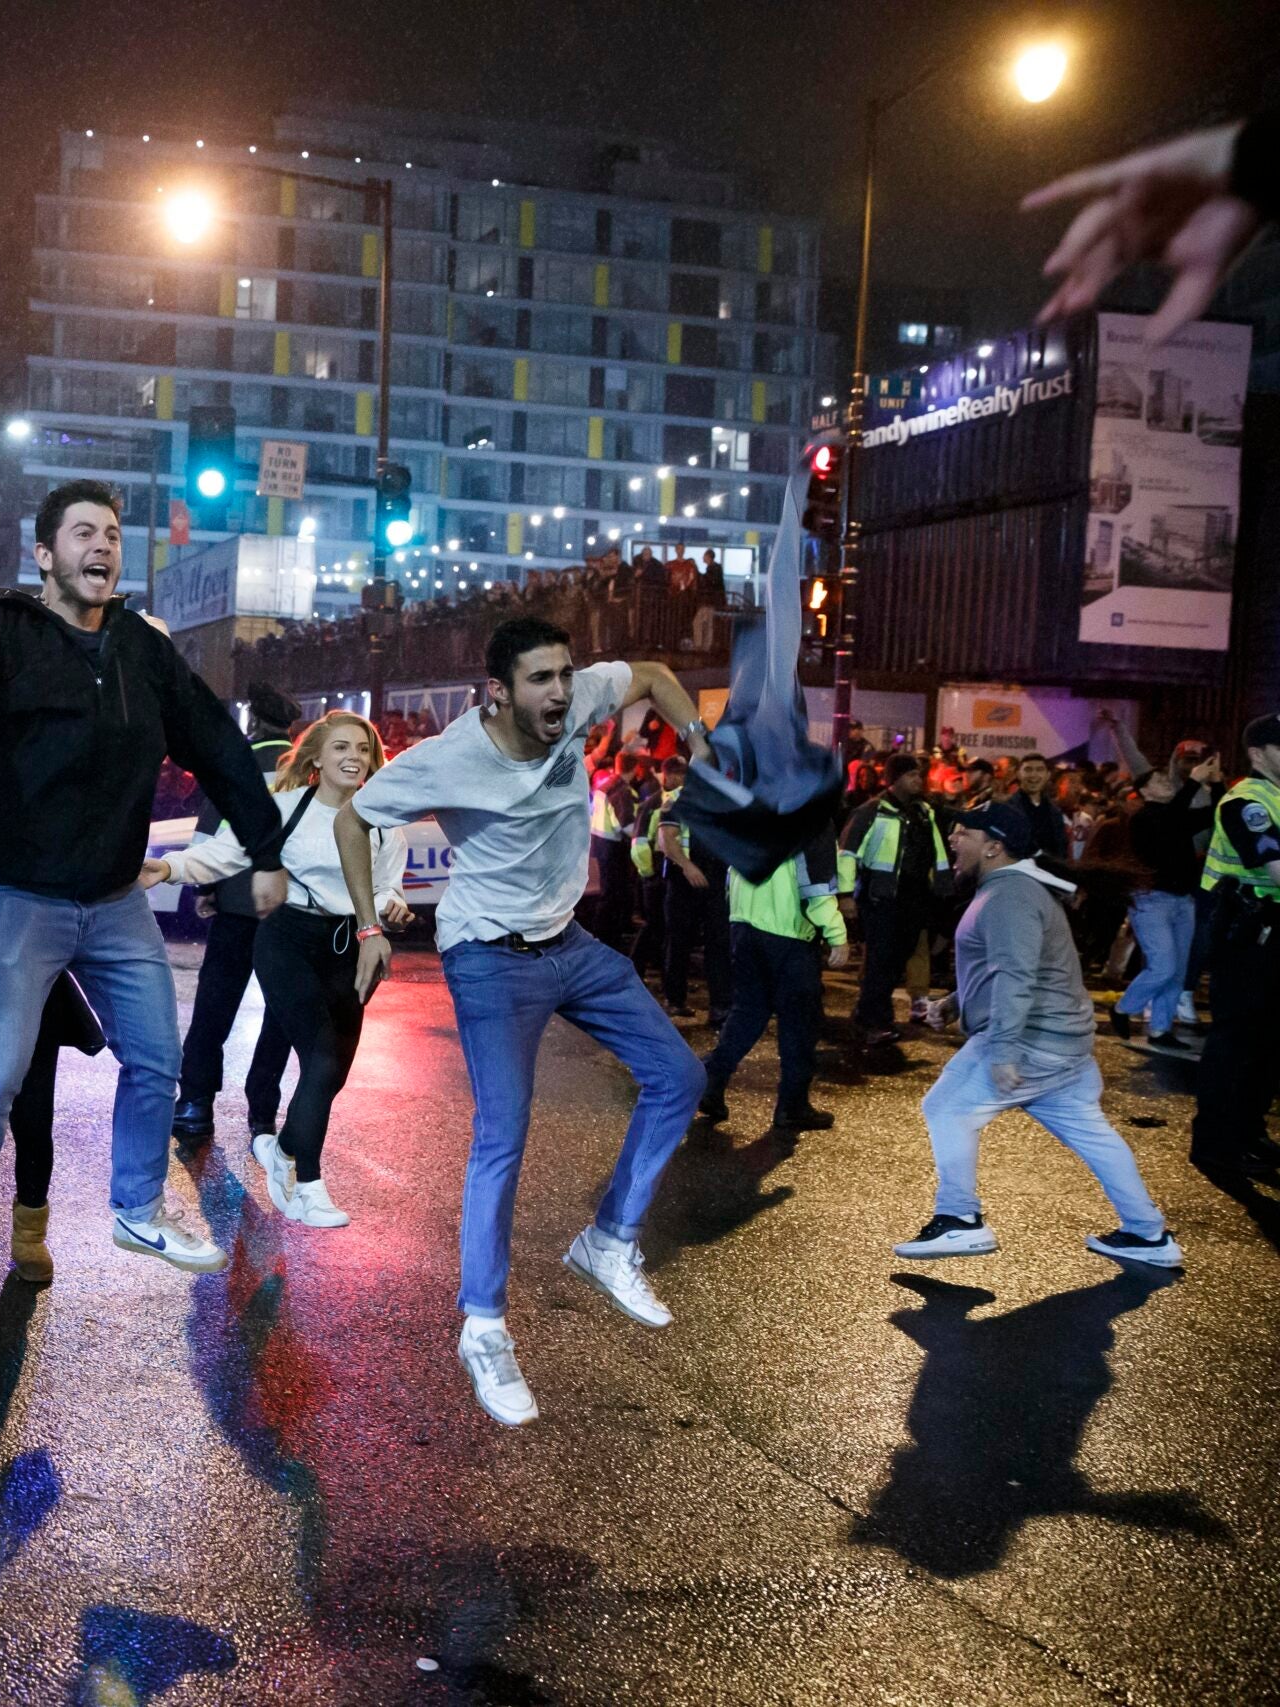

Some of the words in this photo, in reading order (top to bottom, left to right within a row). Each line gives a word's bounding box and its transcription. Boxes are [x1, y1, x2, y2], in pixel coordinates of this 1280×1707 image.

[812, 411, 839, 430] HALF
[278, 447, 291, 458] NO
[268, 456, 297, 469] TURN
[263, 469, 277, 479] ON
[982, 734, 1037, 750] ADMISSION
